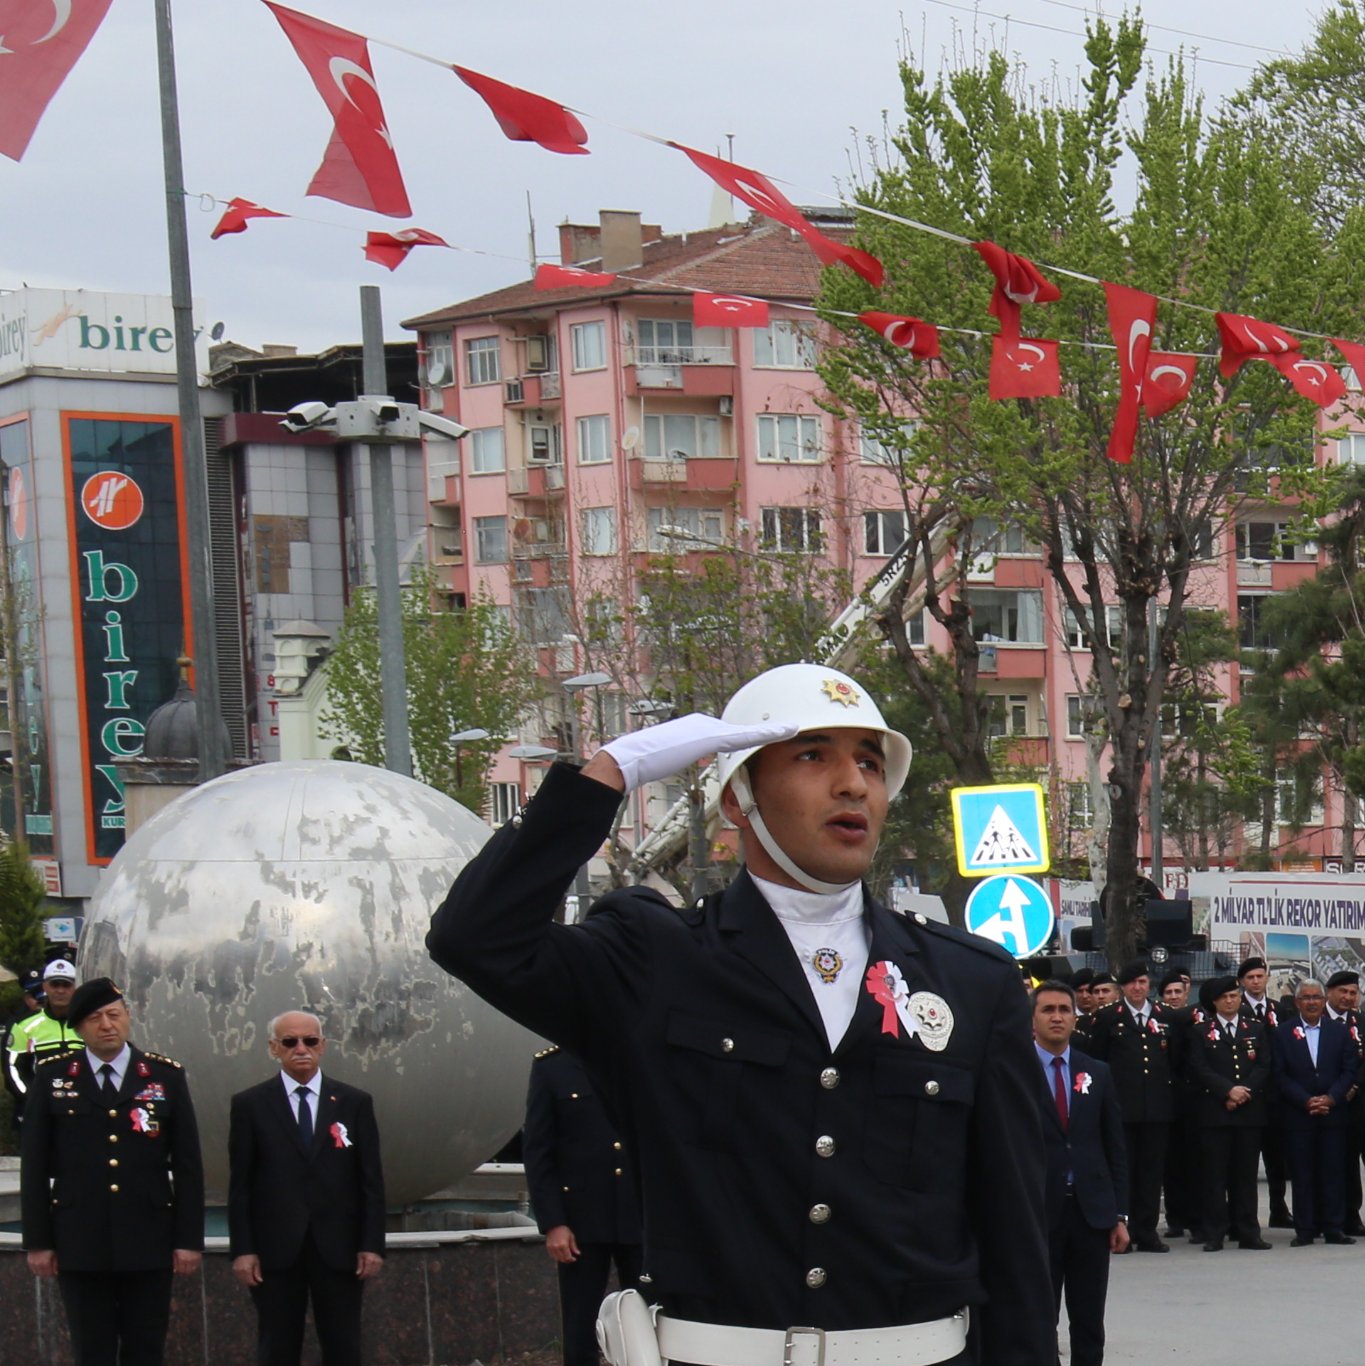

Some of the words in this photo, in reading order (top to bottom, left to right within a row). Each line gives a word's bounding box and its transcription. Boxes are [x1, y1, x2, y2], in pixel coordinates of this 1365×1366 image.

[78, 315, 203, 353] bire
[1214, 897, 1220, 923] 2
[1221, 887, 1255, 924] MİLYAR
[1286, 898, 1321, 927] REKOR
